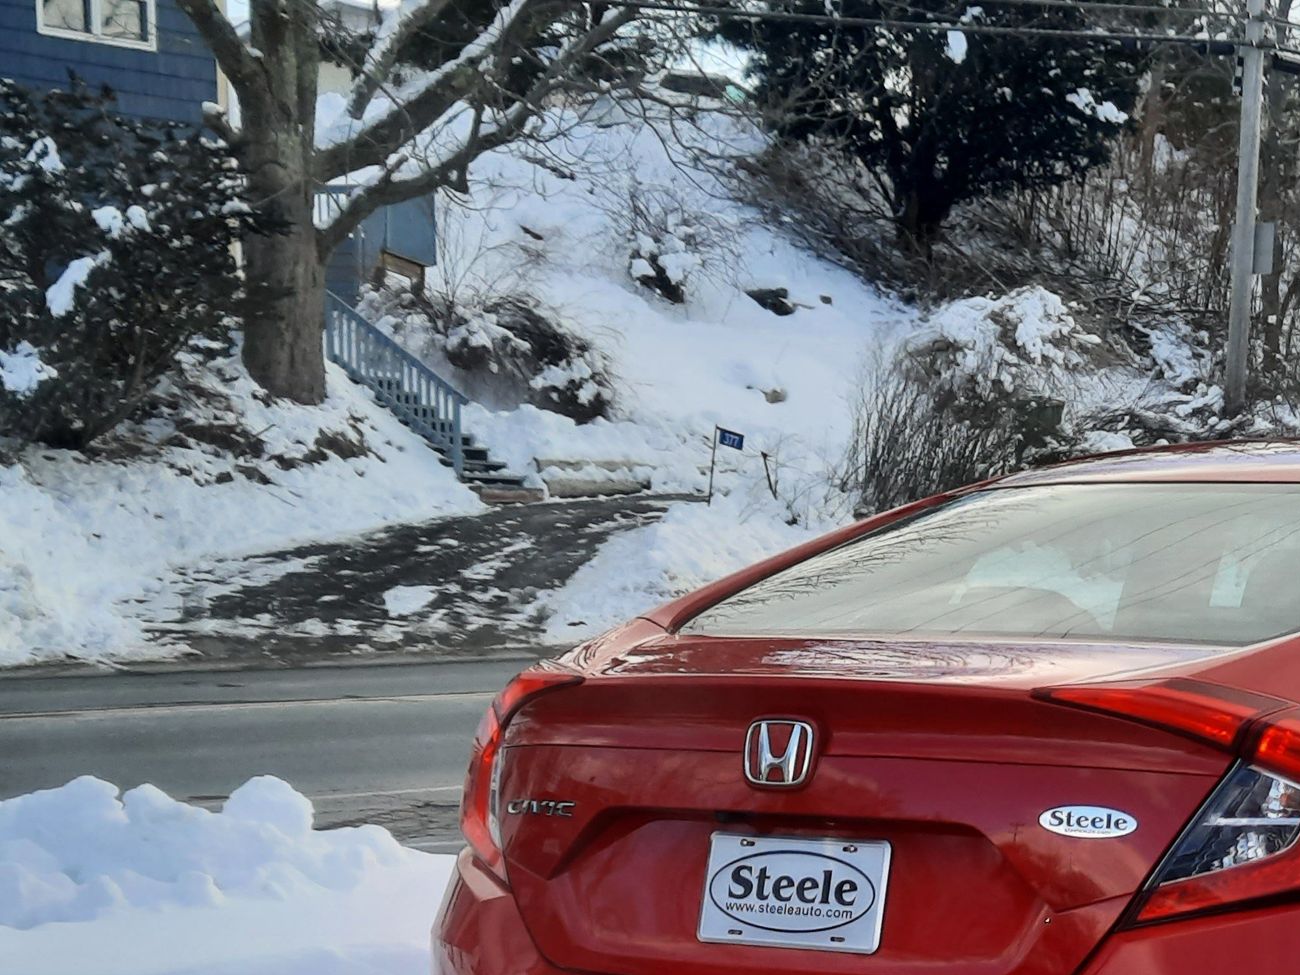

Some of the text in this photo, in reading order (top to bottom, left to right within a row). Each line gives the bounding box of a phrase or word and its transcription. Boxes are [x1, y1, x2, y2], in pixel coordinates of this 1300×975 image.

[506, 798, 576, 817] CIVIC
[1049, 810, 1128, 831] Steele
[728, 864, 858, 907] Steele
[725, 901, 853, 919] www.steeleauto.com
